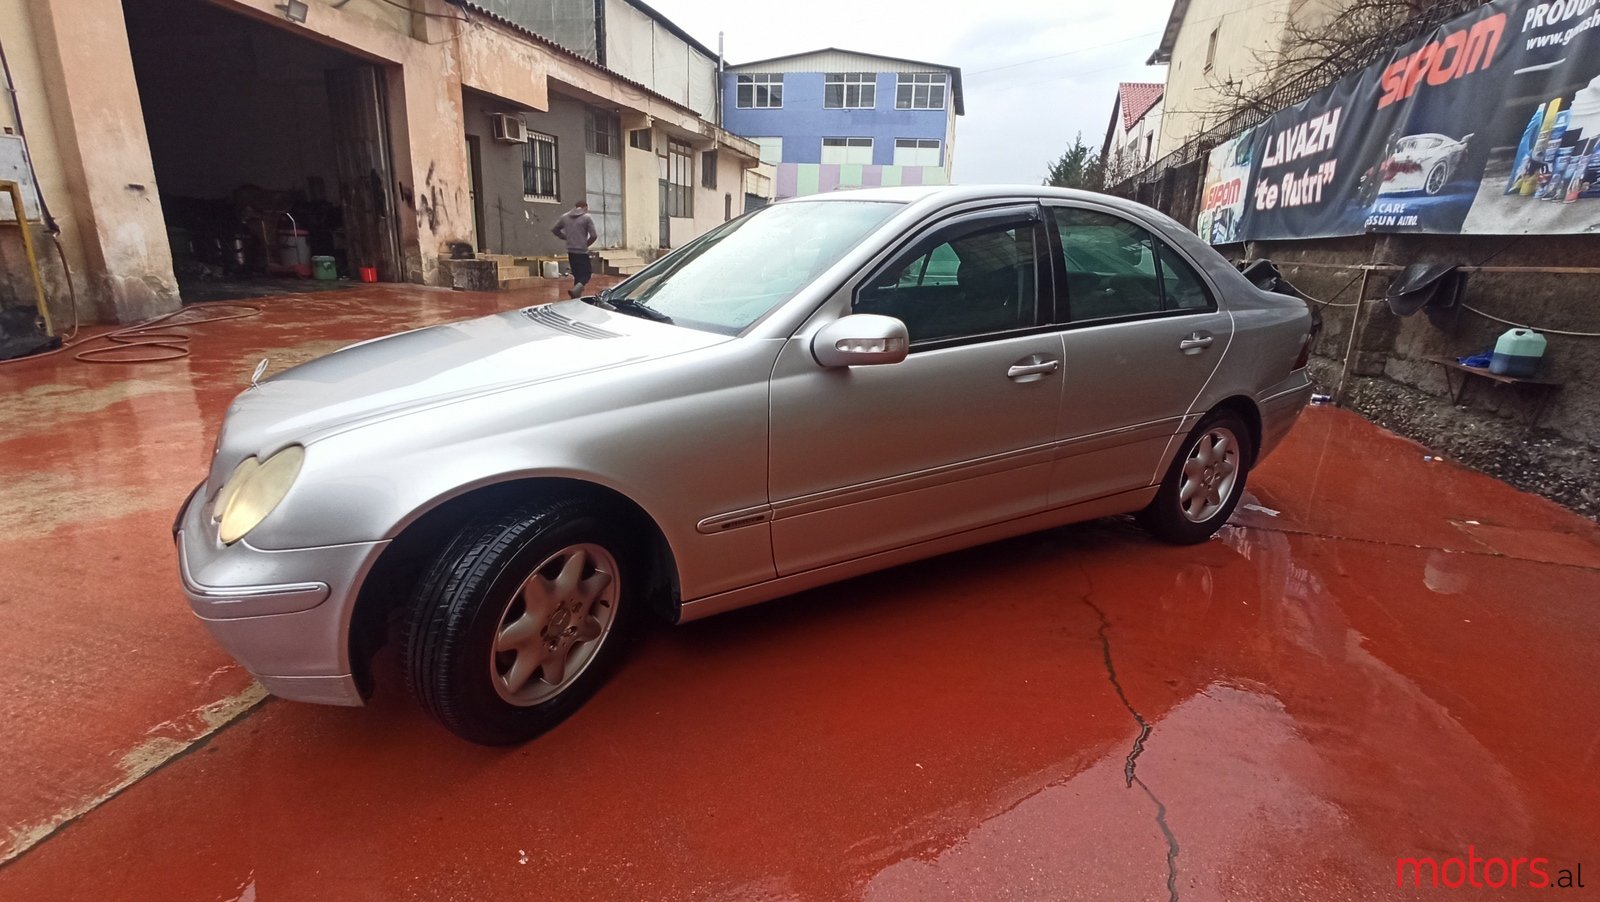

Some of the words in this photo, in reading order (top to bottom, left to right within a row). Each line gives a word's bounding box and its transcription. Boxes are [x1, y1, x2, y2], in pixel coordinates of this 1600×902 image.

[1377, 12, 1507, 110] SIPOM
[1261, 107, 1342, 169] LAVAZH
[1206, 178, 1242, 211] SIPOM
[1378, 202, 1406, 214] CARE
